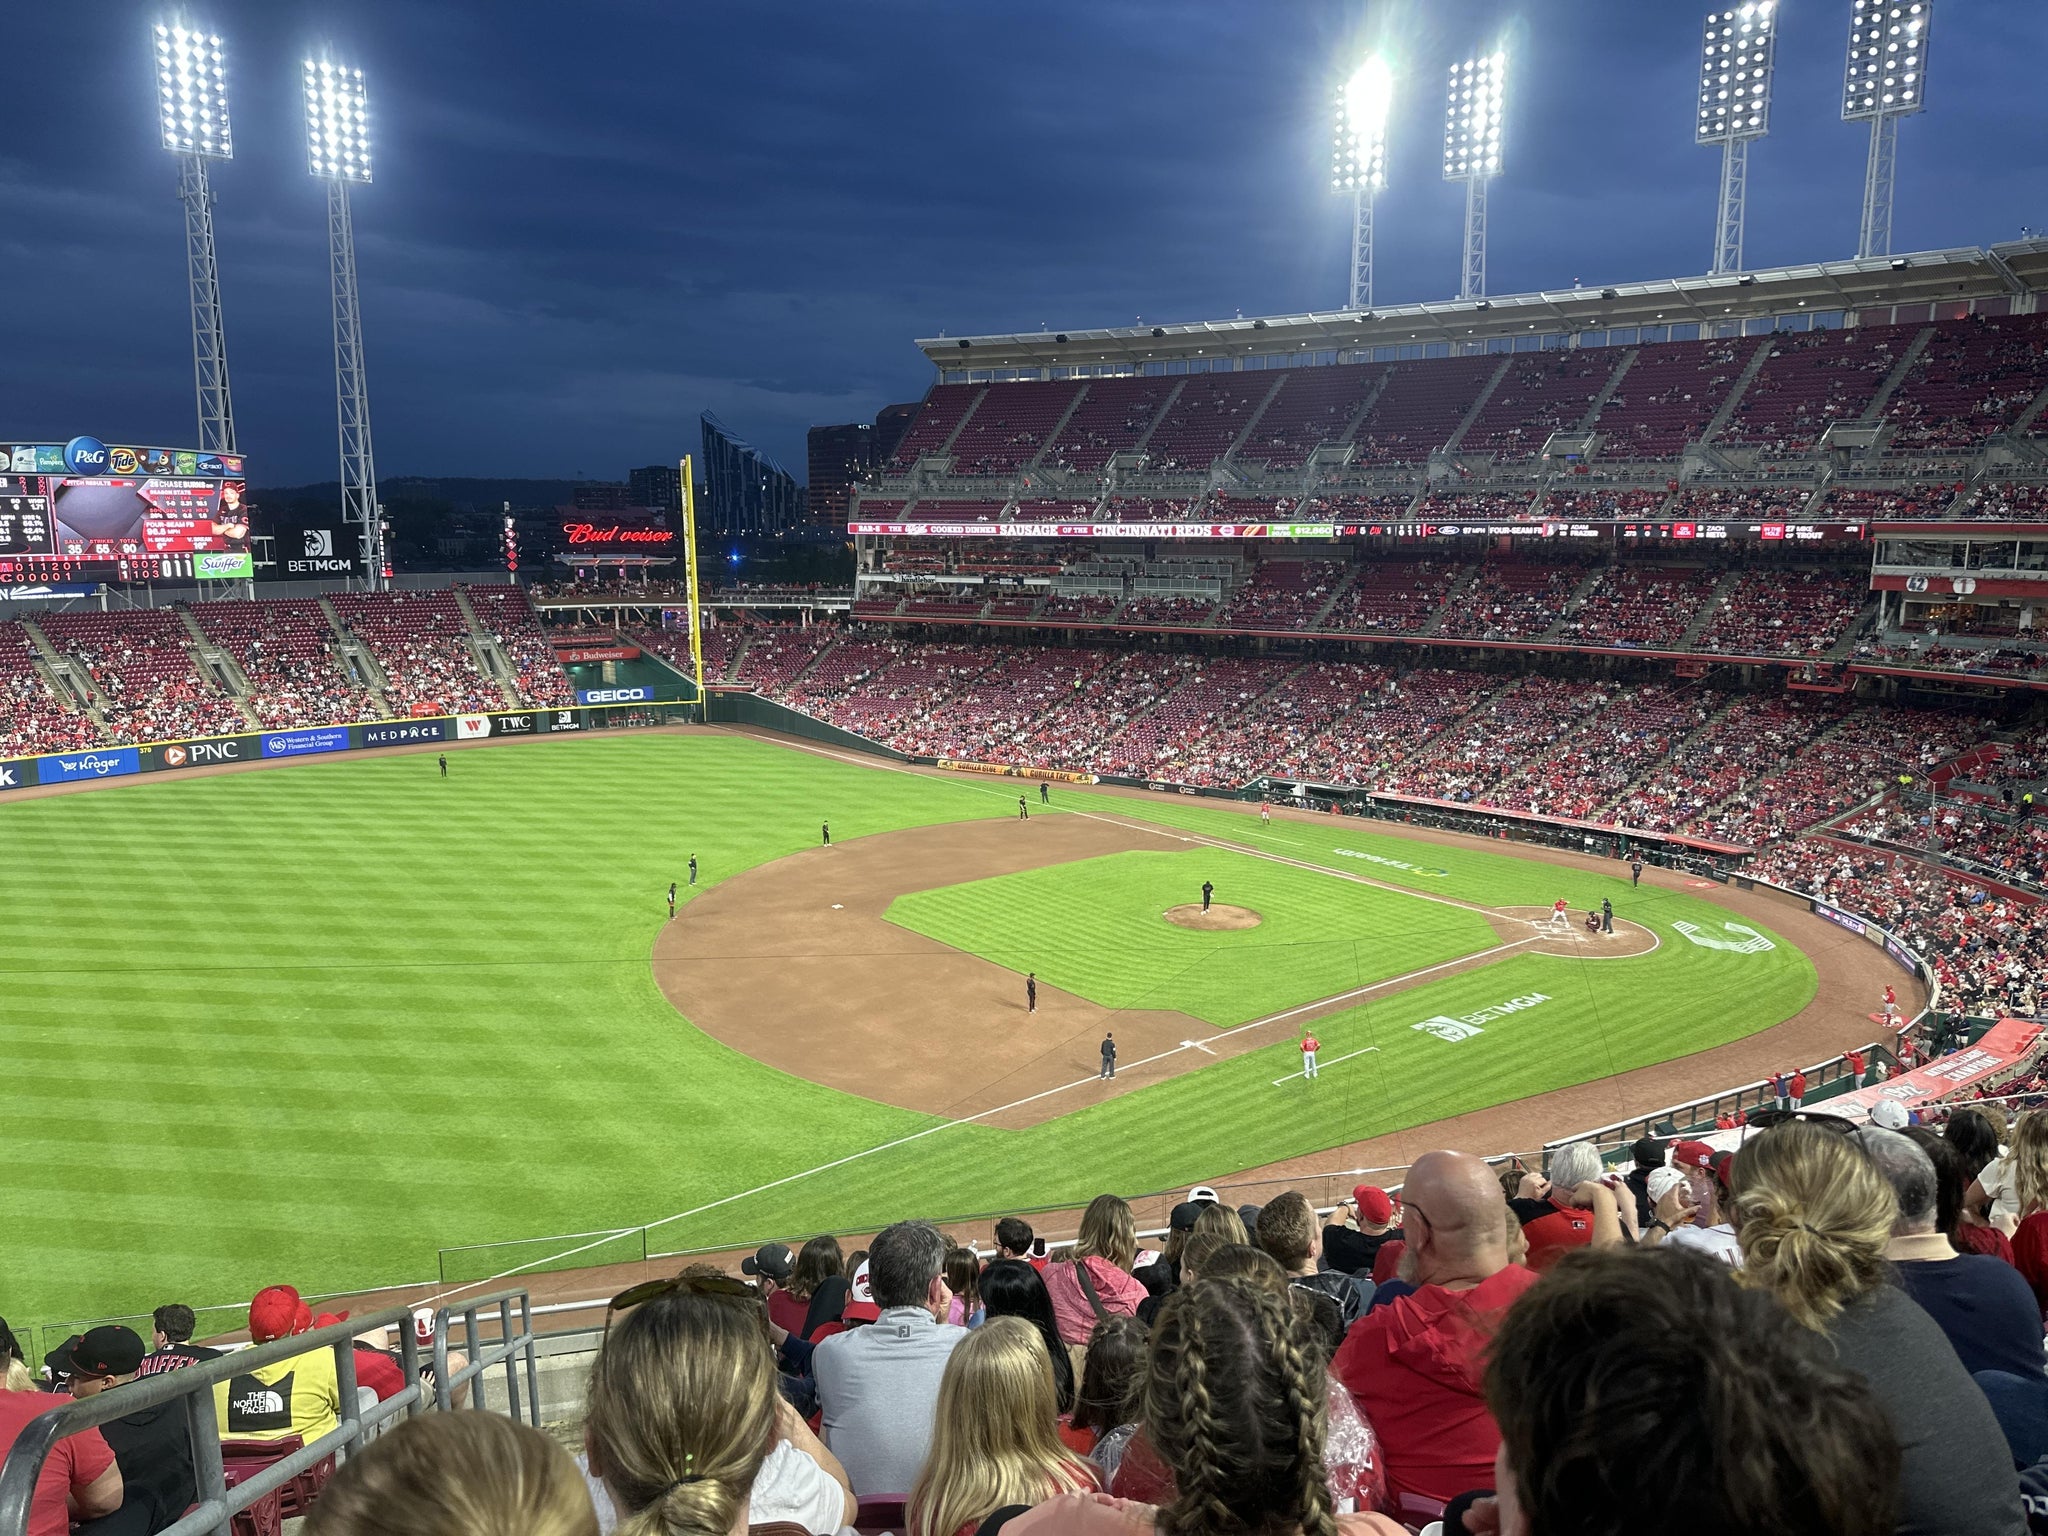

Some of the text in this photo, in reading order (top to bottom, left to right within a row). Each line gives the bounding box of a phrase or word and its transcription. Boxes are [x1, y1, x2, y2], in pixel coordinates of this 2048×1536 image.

[40, 457, 64, 467] Pampers
[75, 449, 105, 464] P&G
[112, 454, 135, 470] Tide
[159, 480, 182, 489] CHASE
[858, 525, 880, 533] BAR-S
[930, 525, 964, 533] COOKED
[965, 525, 997, 533] DINNER
[999, 525, 1058, 536] SAUSAGE
[1092, 525, 1171, 536] CINCINNATI
[1176, 525, 1211, 536] REDS
[1360, 527, 1366, 535] 5
[1490, 527, 1534, 535] FOUR-SEAM
[1534, 527, 1543, 535] FB
[68, 544, 83, 554] 35
[122, 543, 137, 554] 90
[15, 563, 23, 572] 0
[28, 563, 34, 571] 1
[41, 562, 46, 571] 1
[52, 562, 59, 571] 2
[63, 562, 71, 570] 0
[76, 562, 81, 570] 1
[120, 560, 128, 569] 5
[131, 560, 138, 568] 6
[141, 560, 148, 568] 0
[151, 560, 158, 568] 2
[162, 560, 192, 577] 0 1 1
[201, 558, 243, 573] Swiffer
[288, 560, 352, 572] BETMGM
[16, 574, 24, 582] 0
[28, 573, 36, 582] 0
[41, 573, 48, 581] 0
[53, 572, 60, 581] 0
[65, 572, 71, 580] 1
[121, 570, 127, 579] 1
[142, 570, 149, 578] 0
[152, 570, 159, 578] 3
[1907, 577, 1925, 591] 42
[583, 651, 624, 660] Budweiser
[587, 688, 645, 703] GEICO
[498, 716, 532, 730] TWC
[551, 722, 579, 731] BETMGM
[286, 737, 309, 745] Western
[317, 733, 342, 742] Southern
[368, 726, 440, 743] MEDPACE
[288, 740, 334, 751] Financial Group
[189, 742, 239, 762] PNC
[80, 755, 120, 774] Kroger
[957, 762, 997, 774] GORILLA GLUE
[1029, 769, 1070, 781] GORILLA TAPE
[1460, 992, 1553, 1025] BETMGM
[247, 1391, 266, 1400] THE
[233, 1399, 266, 1409] NORTH
[242, 1405, 265, 1415] FACE
